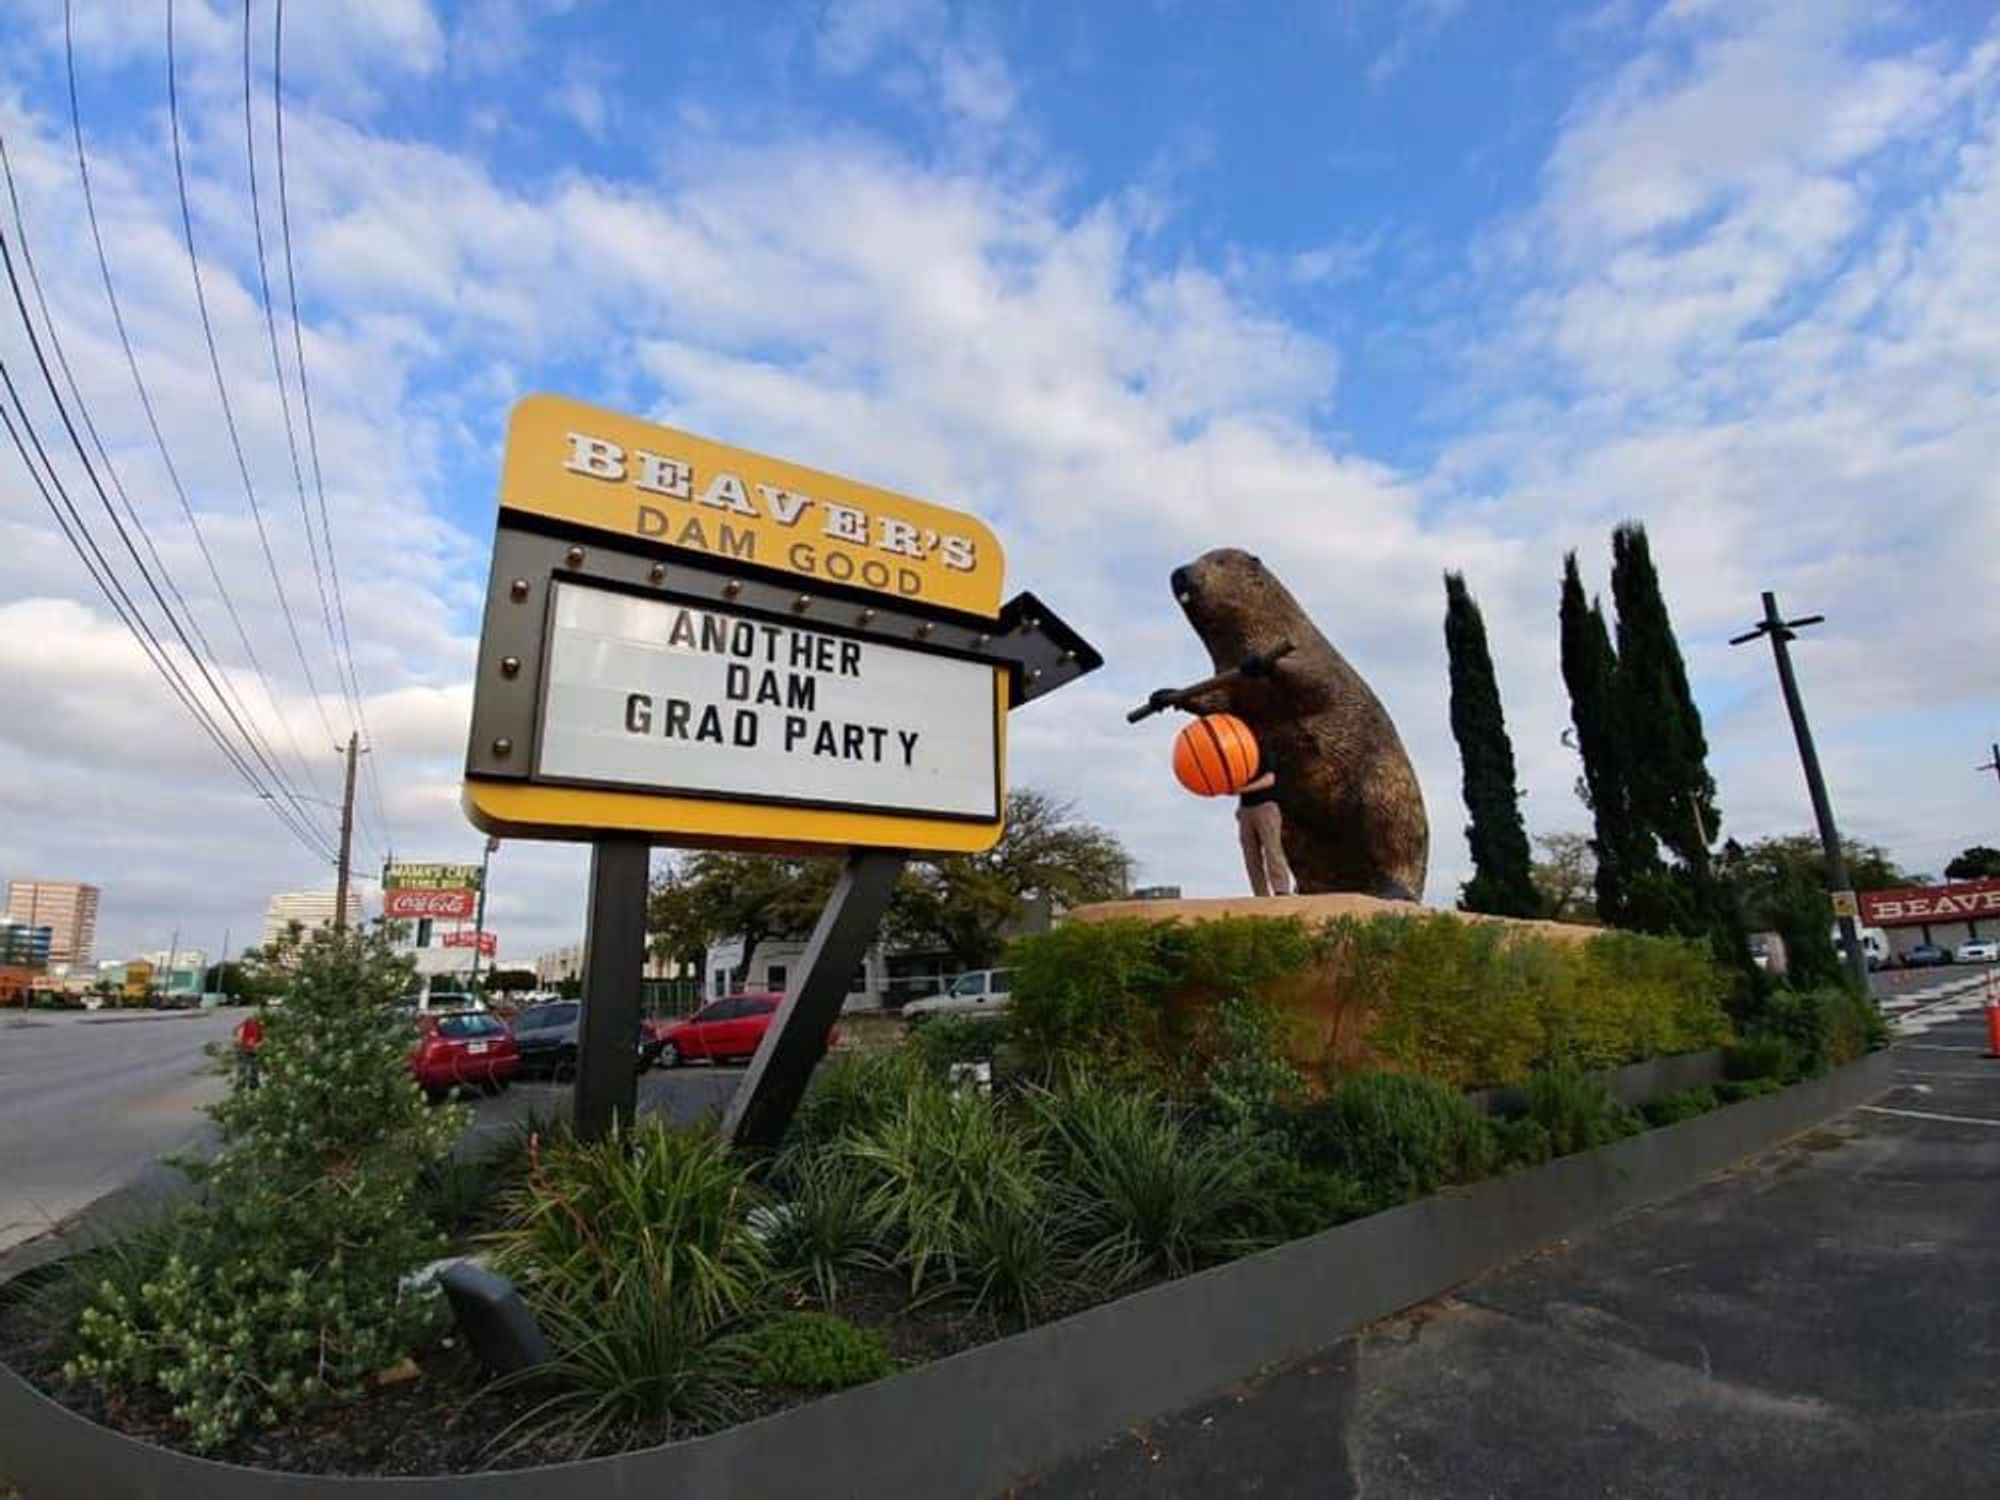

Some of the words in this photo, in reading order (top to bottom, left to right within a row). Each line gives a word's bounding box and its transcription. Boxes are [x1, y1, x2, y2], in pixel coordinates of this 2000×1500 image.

[563, 432, 977, 572] BEAVER'S
[637, 505, 757, 559] DAM
[789, 543, 922, 596] GOOD
[668, 610, 862, 677] ANOTHER
[726, 662, 815, 711] DAM
[625, 693, 758, 748] GRAD
[785, 716, 919, 766] PARTY
